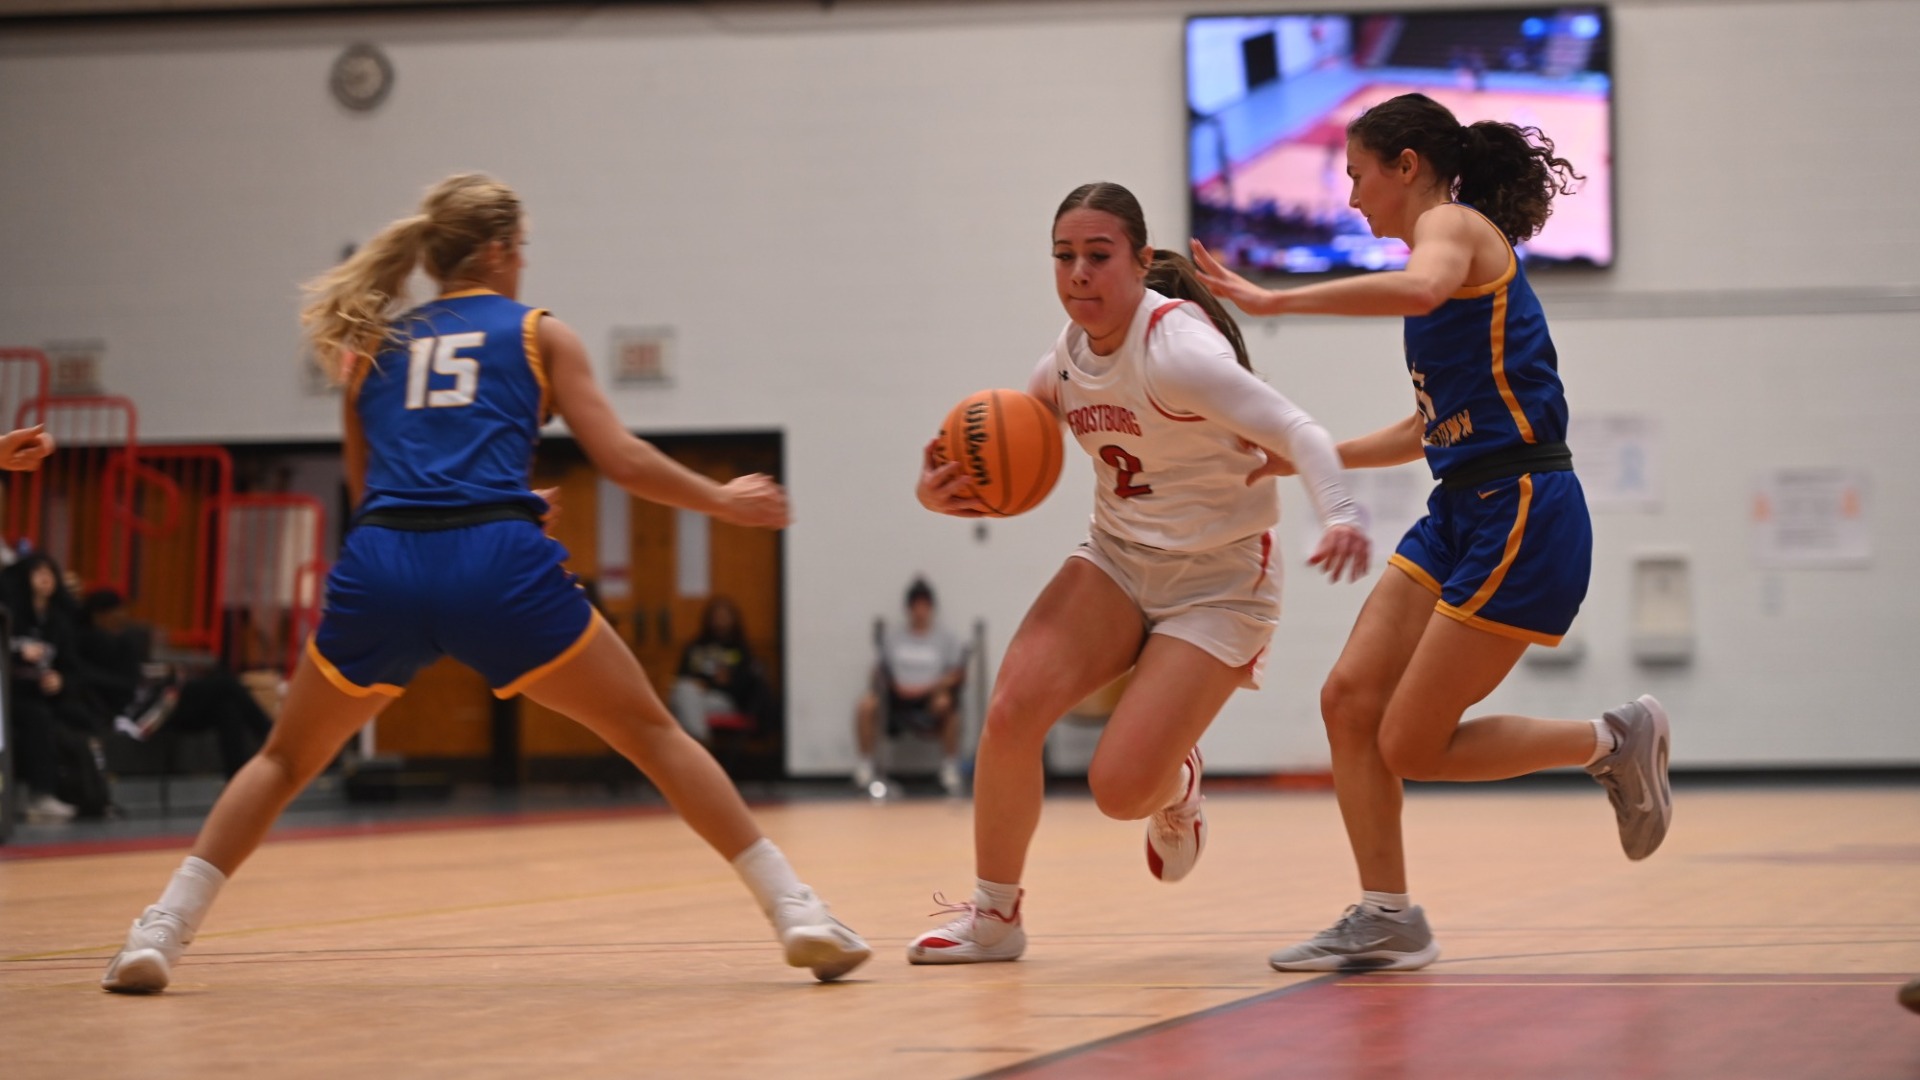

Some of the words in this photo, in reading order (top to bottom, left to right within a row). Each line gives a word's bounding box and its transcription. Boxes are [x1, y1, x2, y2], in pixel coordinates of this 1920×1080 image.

[404, 331, 487, 409] 15
[1067, 404, 1142, 437] FROSTBURG
[1099, 444, 1153, 498] 2
